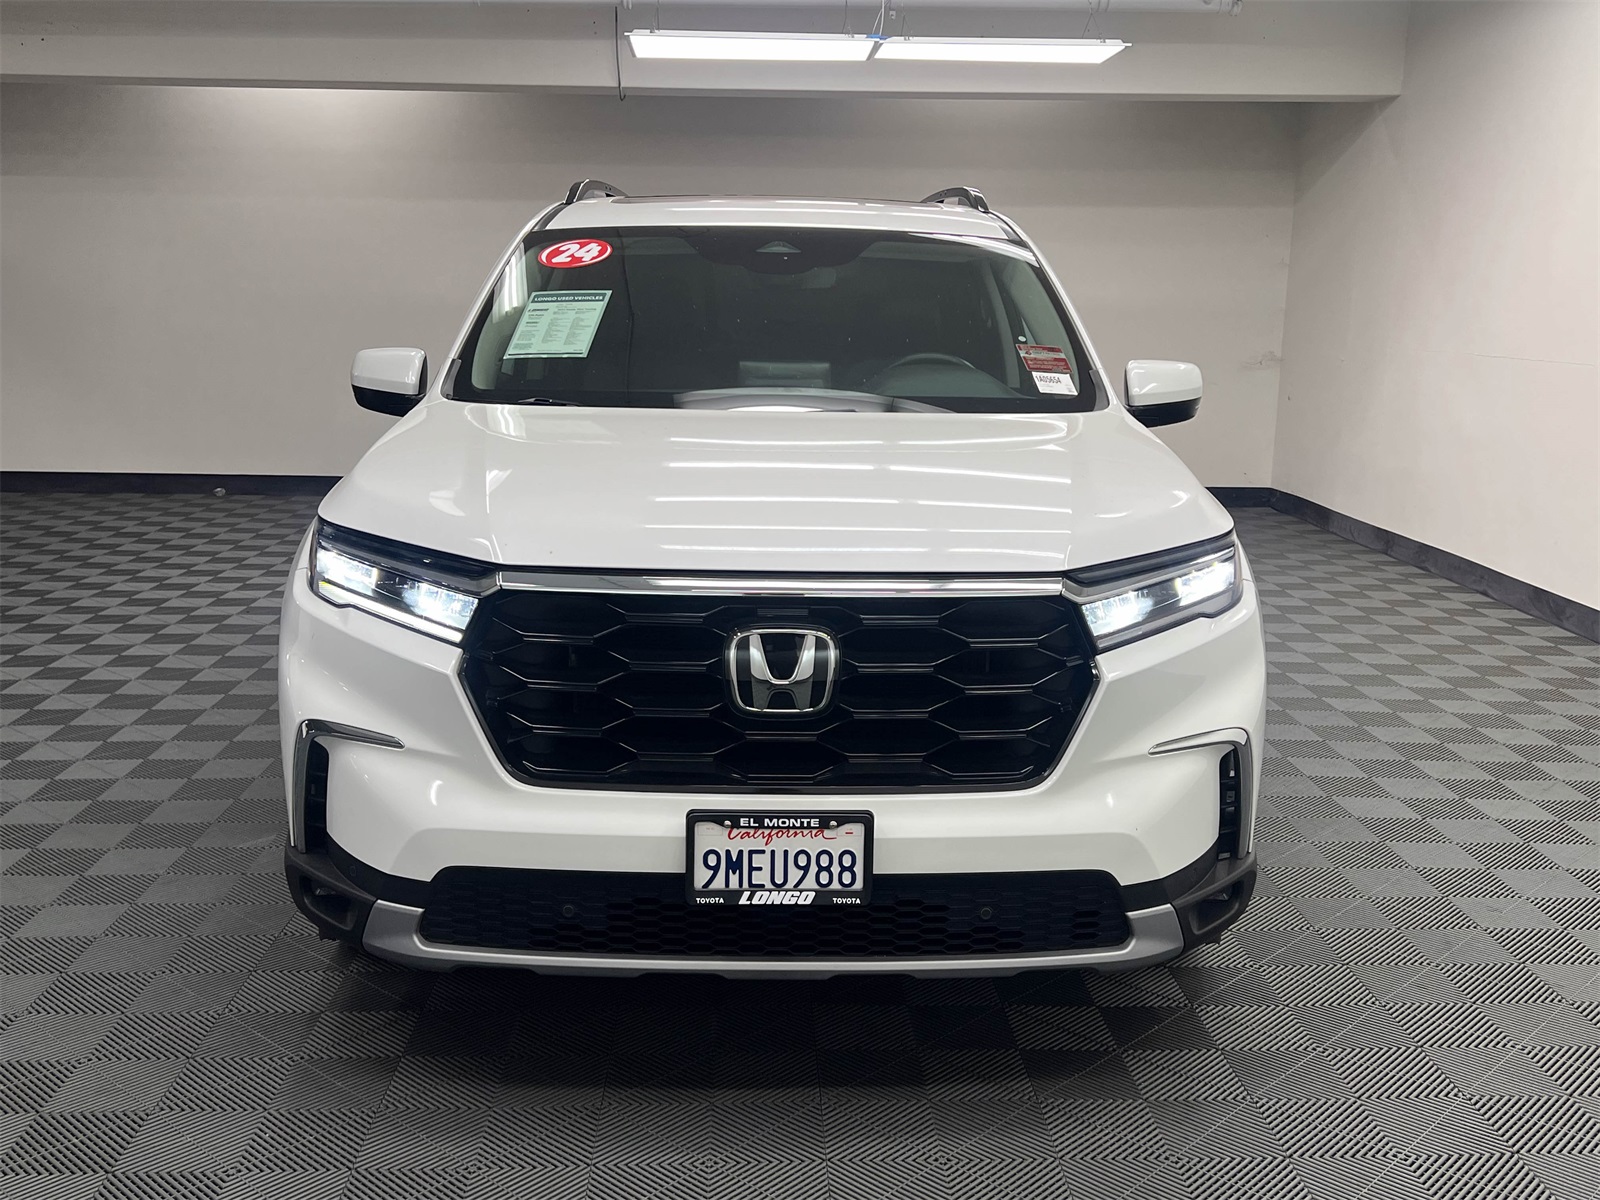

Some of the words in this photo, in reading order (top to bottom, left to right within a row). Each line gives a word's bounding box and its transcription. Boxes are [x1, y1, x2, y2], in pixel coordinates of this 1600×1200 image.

[551, 243, 602, 263] 24
[739, 818, 759, 827] EL
[764, 818, 820, 827] MONTE
[727, 828, 837, 846] California
[701, 849, 857, 889] 9MEU988
[738, 891, 816, 905] LONGO
